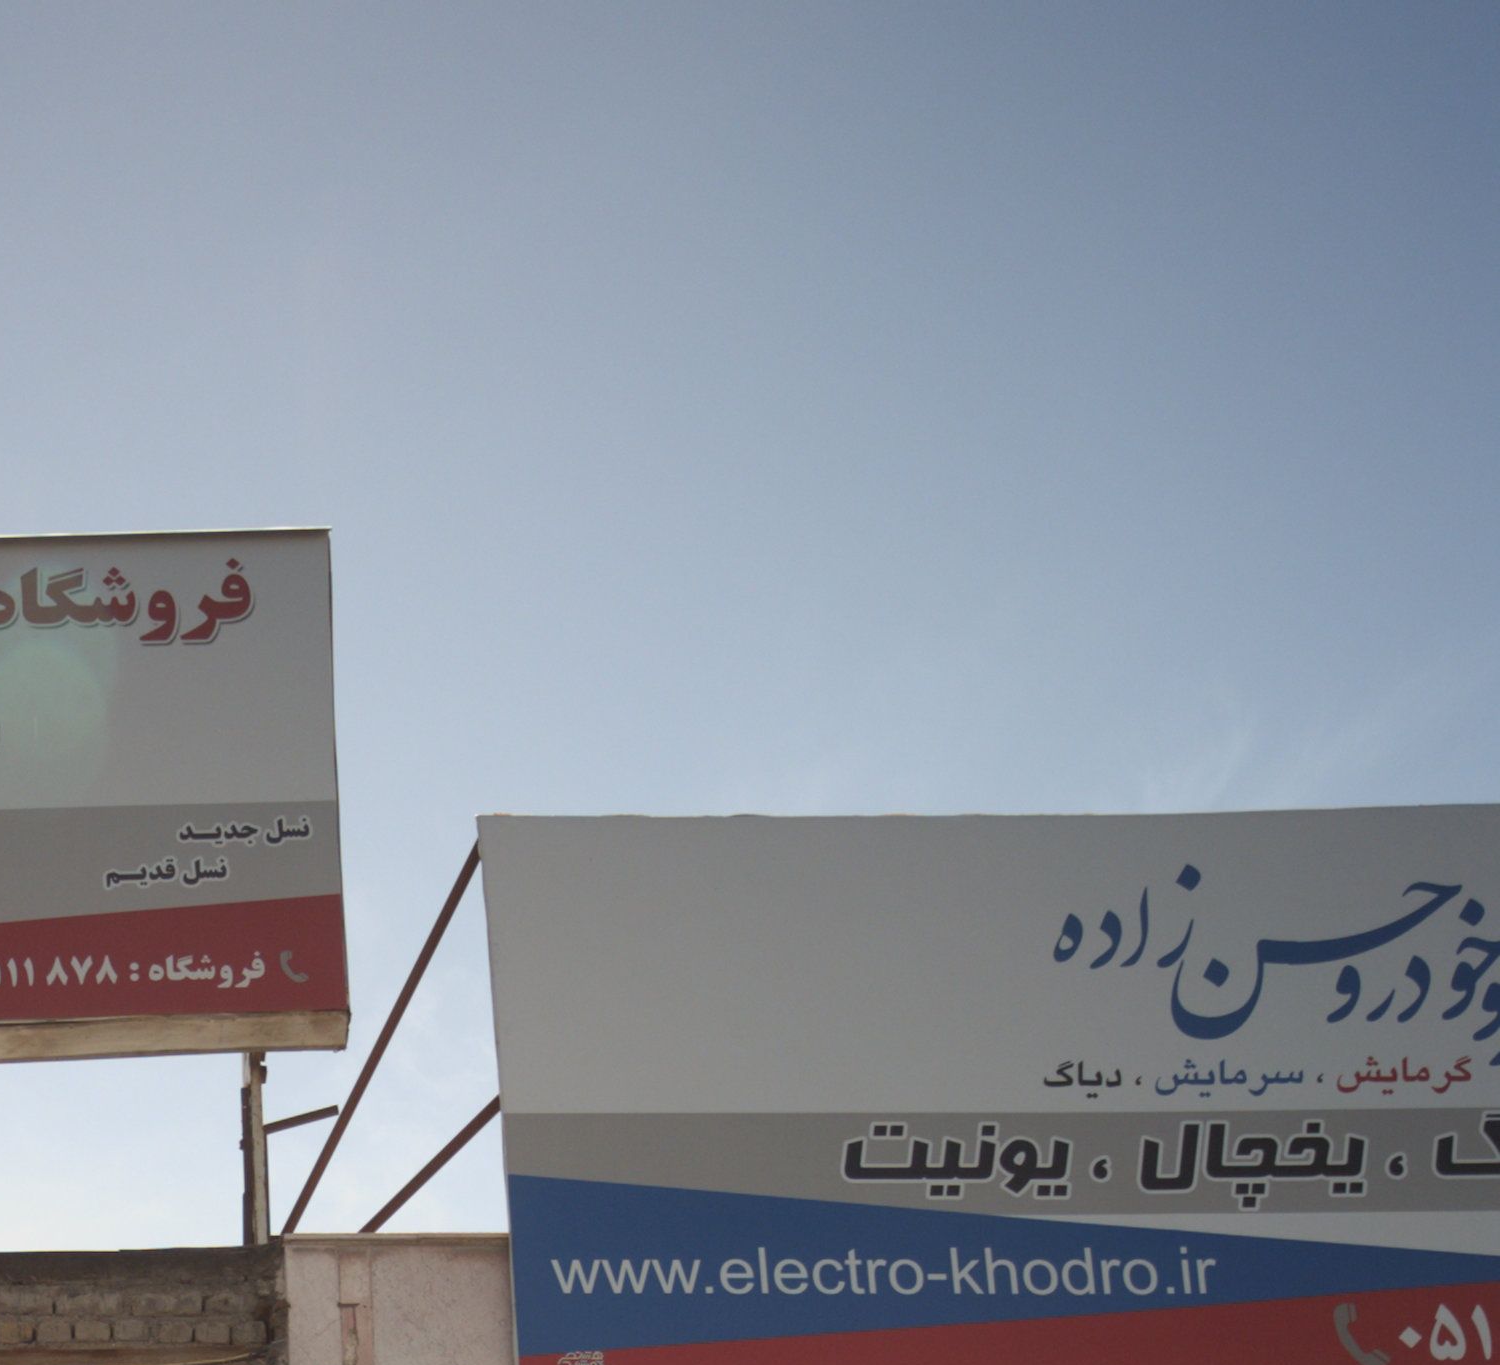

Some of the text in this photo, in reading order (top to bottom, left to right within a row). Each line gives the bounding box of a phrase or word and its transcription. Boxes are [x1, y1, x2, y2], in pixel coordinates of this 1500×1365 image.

[179, 816, 311, 844] نسل جدید
[106, 857, 227, 888] نسل قدیم
[47, 955, 118, 986] ۸۷۸
[1044, 1056, 1472, 1099] گرمایش سرمایش دیاگ
[841, 1119, 1072, 1198] یونیت
[1141, 1120, 1368, 1211] یخچال
[550, 1246, 1215, 1296] www.electro-khodro.ir
